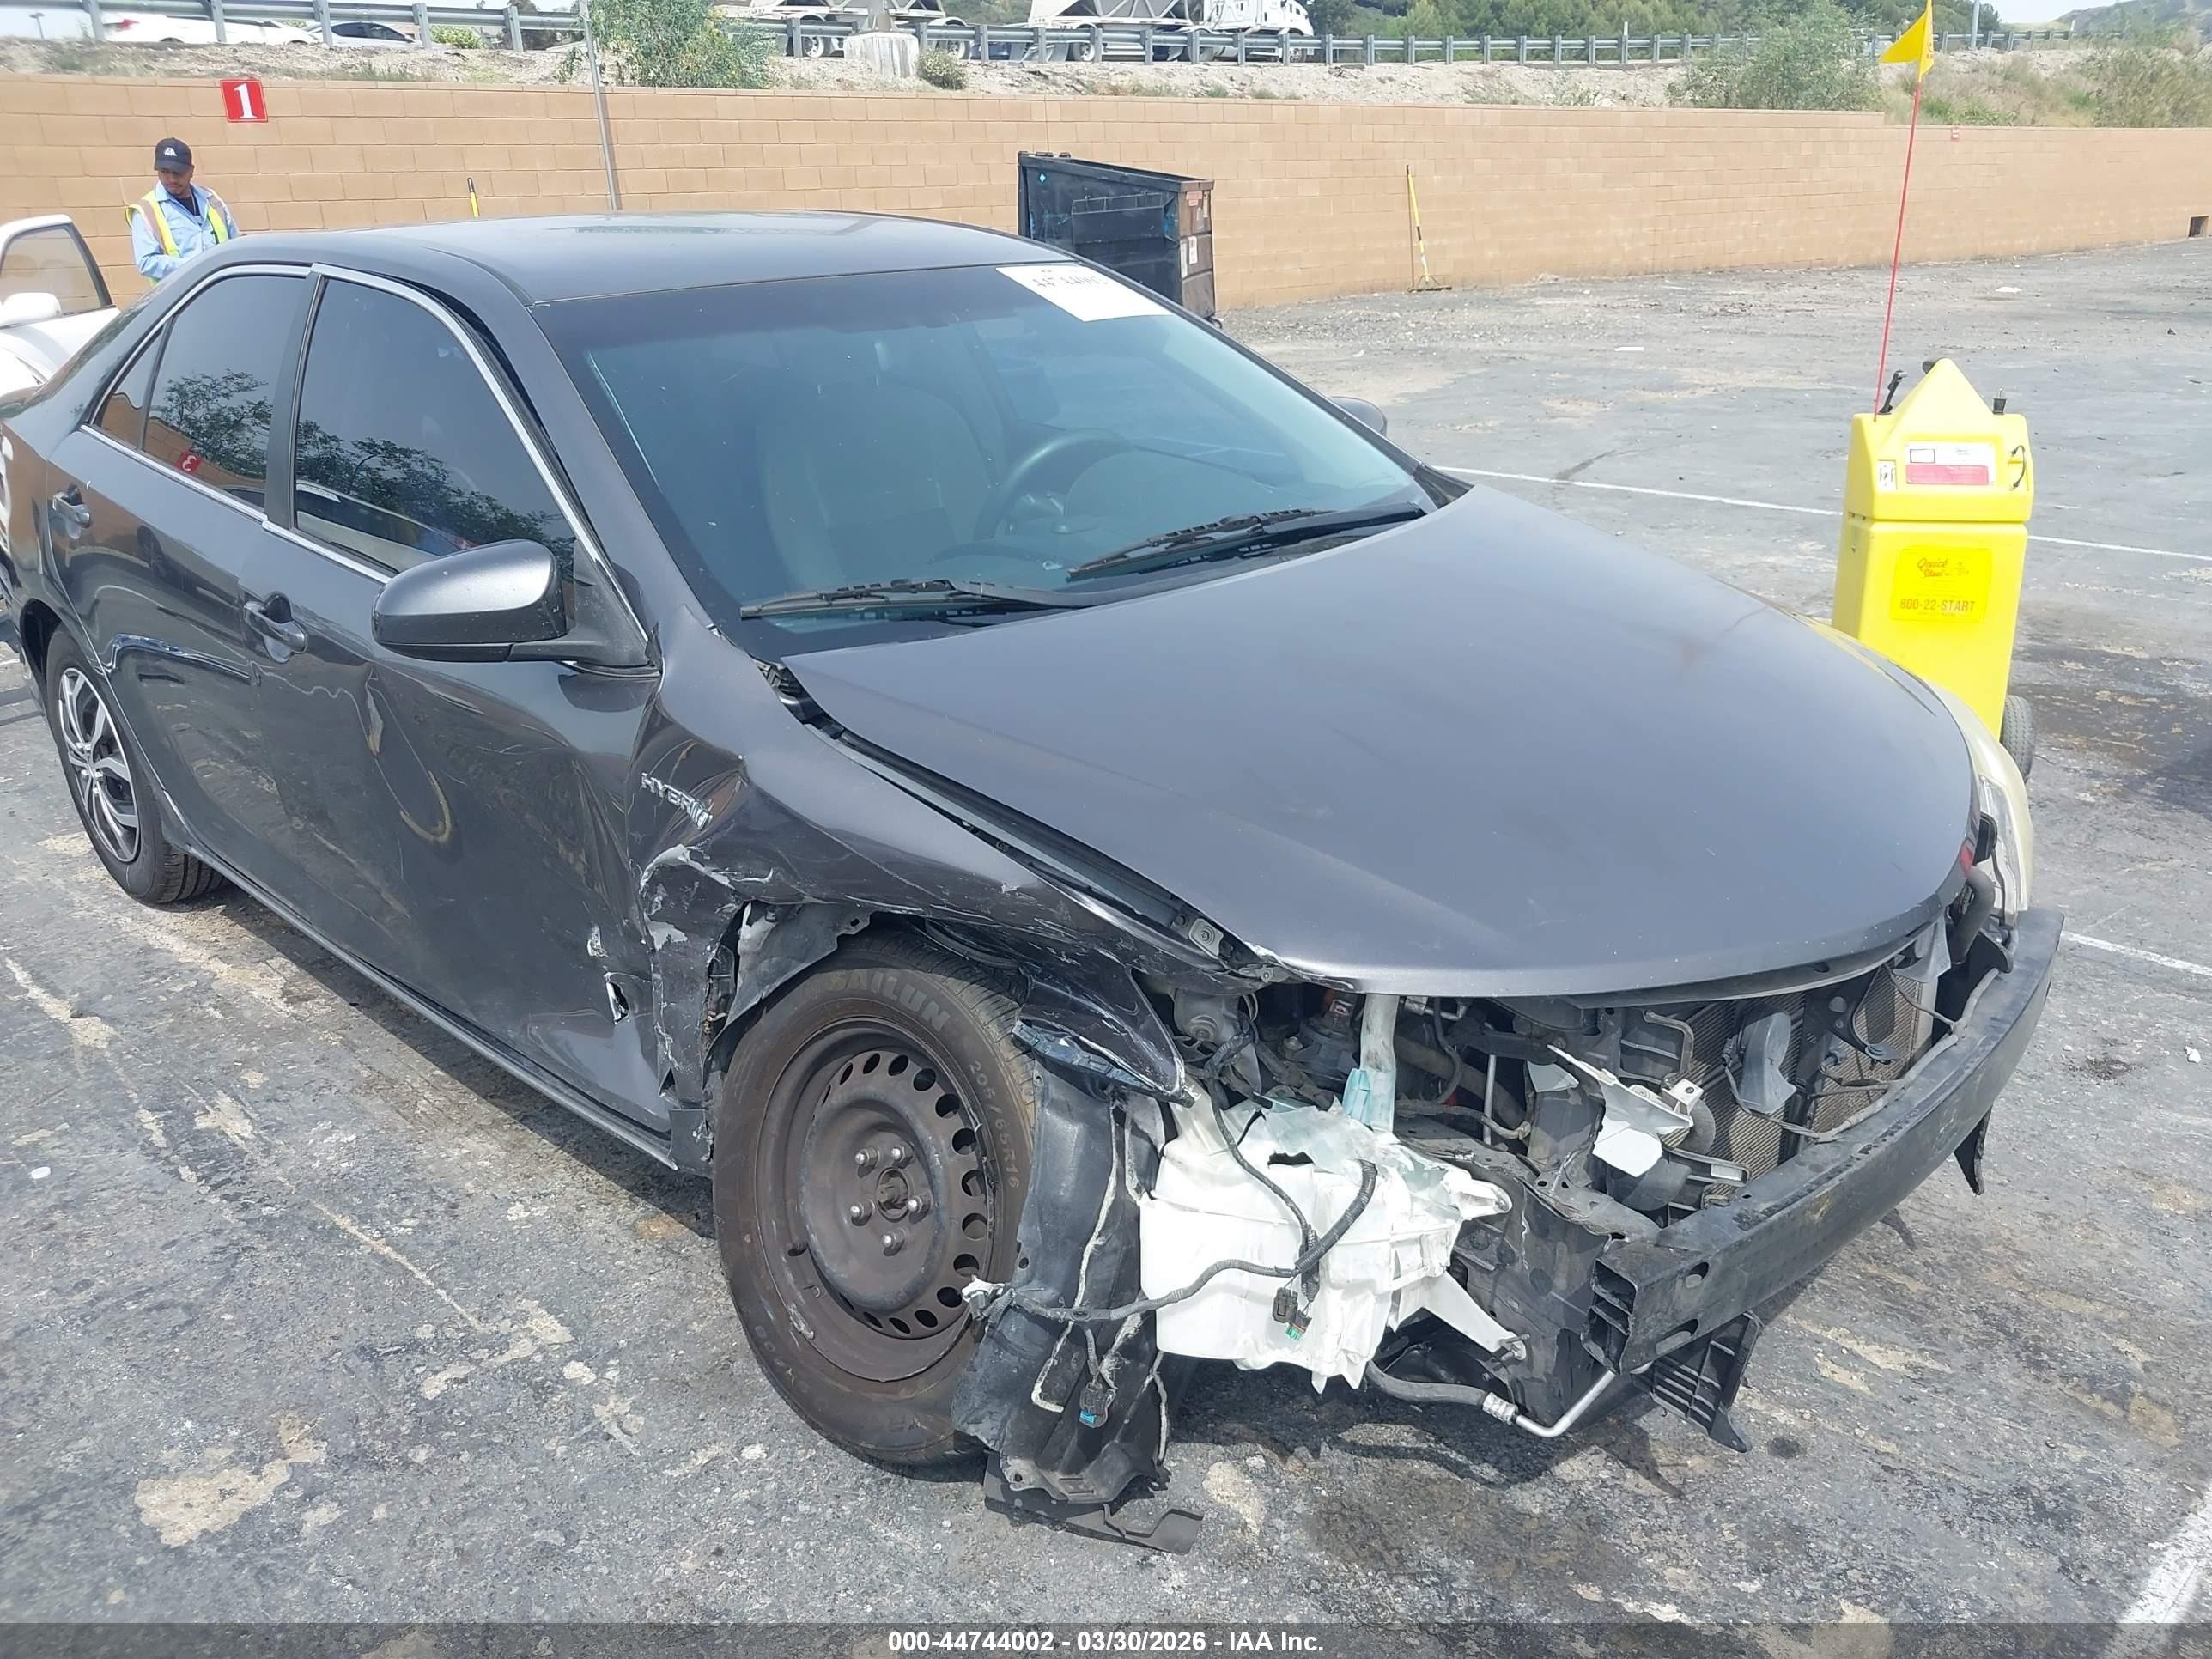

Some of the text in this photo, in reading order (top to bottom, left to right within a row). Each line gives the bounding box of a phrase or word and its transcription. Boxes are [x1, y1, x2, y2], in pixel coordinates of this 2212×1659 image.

[234, 82, 258, 119] 1
[1899, 598, 1977, 612] 800-22-START
[822, 968, 951, 1032] SAILUN
